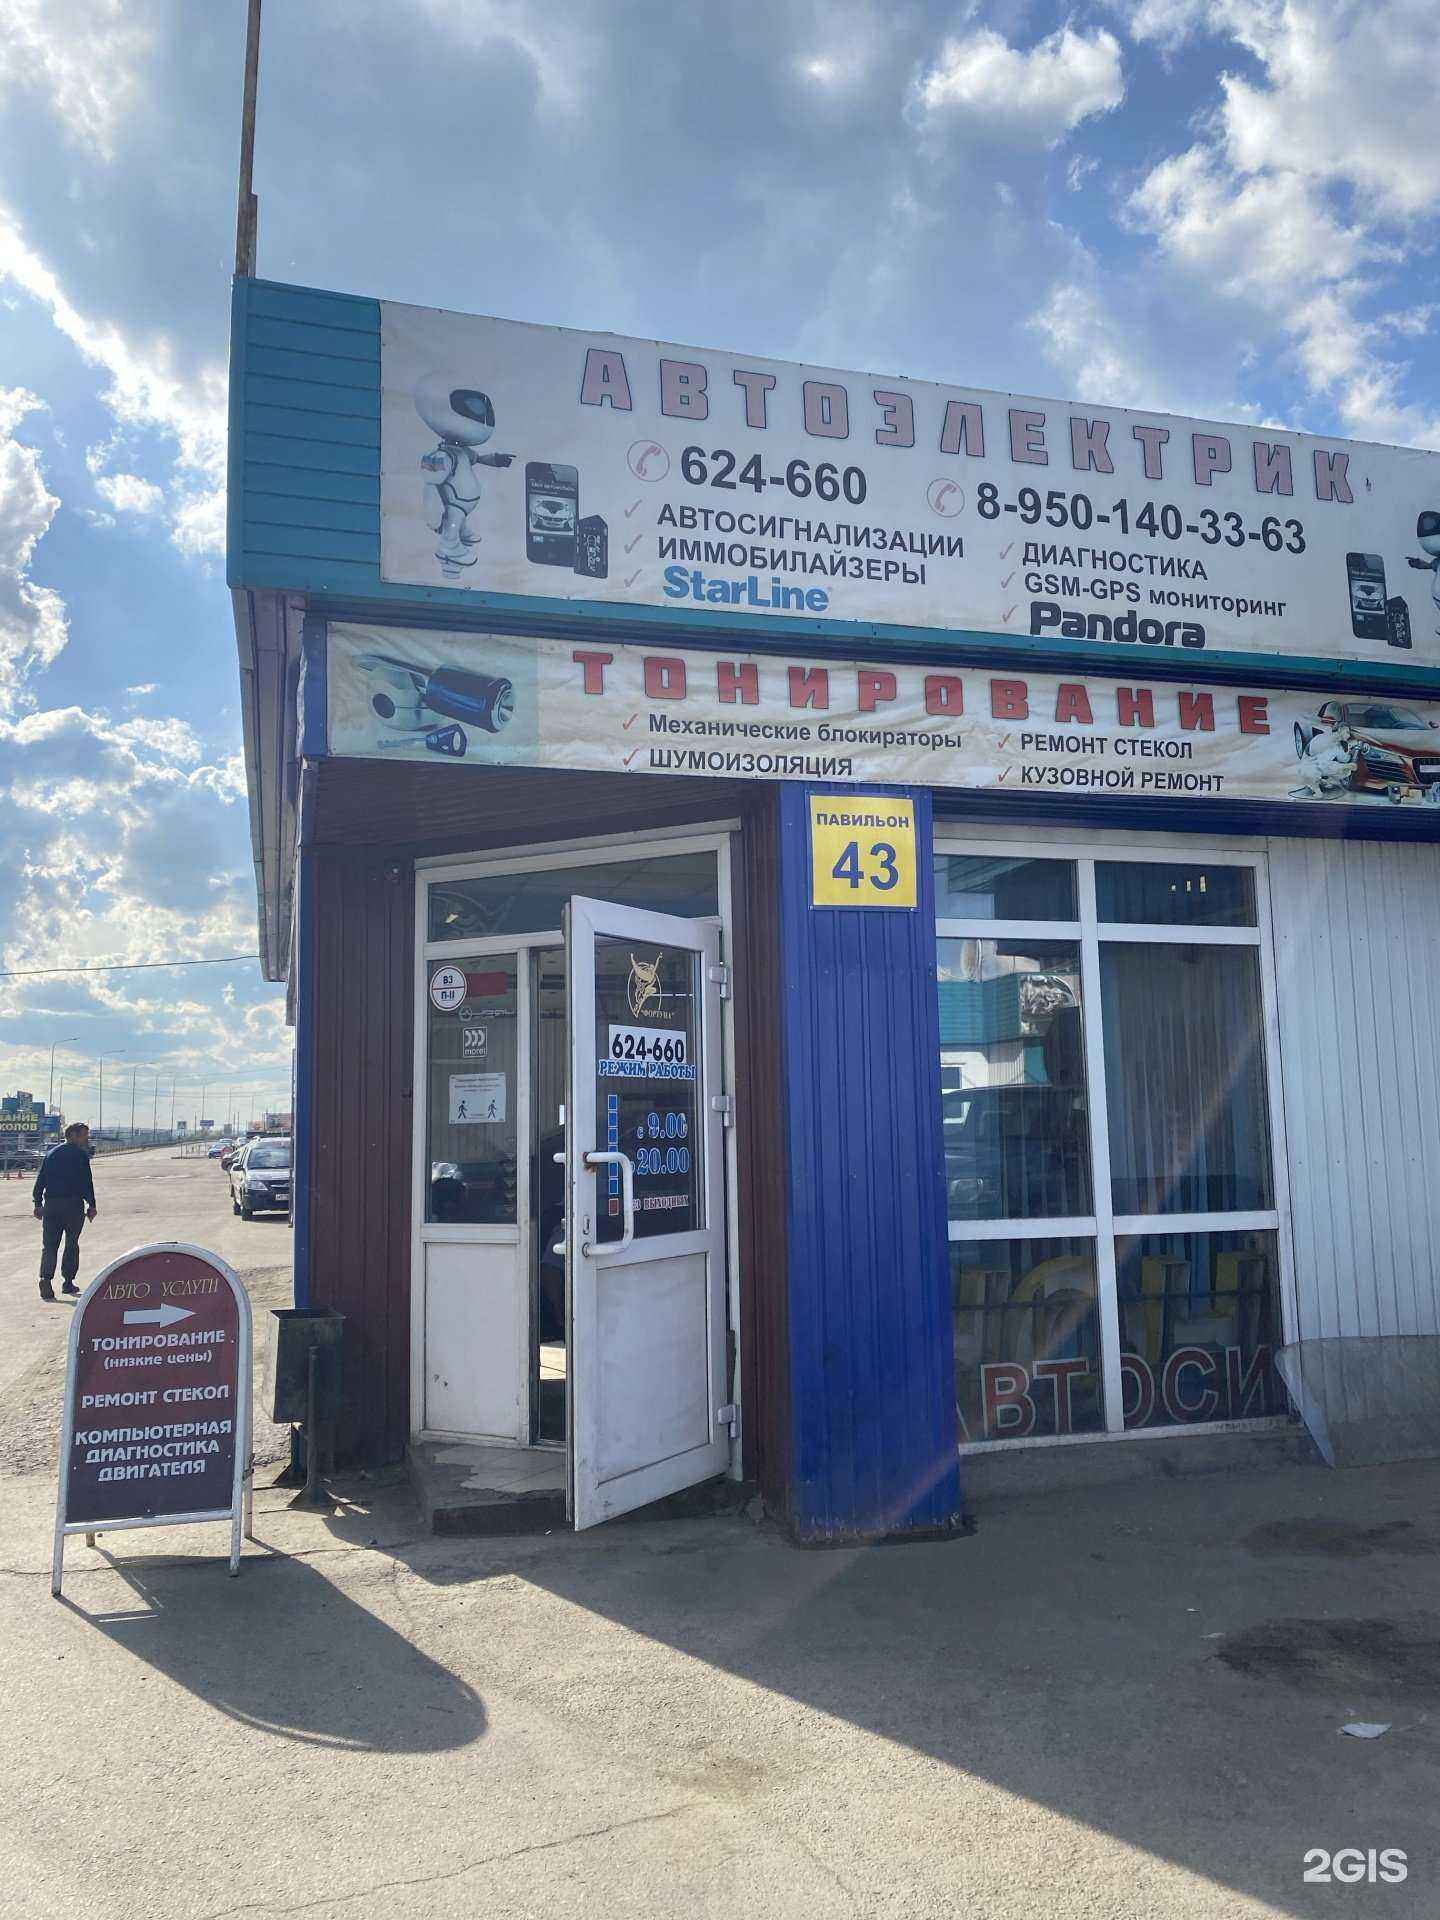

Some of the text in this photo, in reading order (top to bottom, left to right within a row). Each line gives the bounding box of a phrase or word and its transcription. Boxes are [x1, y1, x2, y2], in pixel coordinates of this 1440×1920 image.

[581, 348, 1353, 503] АВТОЭЛЕКТРИК
[681, 446, 867, 505] 624-660
[657, 503, 965, 558] АВТОСИГНАЛИЗАЦИИ
[977, 482, 1307, 554] 8-950-140-33-63
[658, 536, 926, 585] ИММОБИЛАЙЗЕРЫ
[1022, 542, 1208, 580] ДИАГНОСТИКА
[663, 566, 829, 612] StarLine
[1024, 572, 1287, 618] GSM-GPS мониторинг
[1031, 601, 1206, 649] Pandora
[572, 651, 1271, 735] ТОНИРОВАНИЕ
[649, 714, 962, 750] Механические блокираторы
[1021, 734, 1193, 759] РЕМОНТ СТЕКОЛ
[650, 748, 853, 777] ШУМОИЗОЛЯЦИЯ
[1021, 764, 1225, 793] КУЗОВНОЙ РЕМОНТ
[816, 813, 909, 828] ПАВИЛЬОН
[832, 841, 899, 890] 43
[612, 1034, 685, 1062] 624-660
[599, 1060, 696, 1079] РЕЖИМ РАБОТЫ
[637, 1147, 689, 1175] 20.00
[104, 1278, 219, 1300] АВТО УСЛУГИ
[92, 1330, 225, 1351] ТОНИРОВАНИЕ
[104, 1350, 212, 1369] (низкие цены)
[82, 1385, 229, 1408] РЕМОНТ СТЕКОЛ
[956, 1345, 1266, 1440] ВТОСИ
[75, 1420, 232, 1445] КОМПЬЮТЕРНАЯ
[86, 1439, 220, 1463] ДИАГНОСТИКА
[98, 1459, 206, 1482] ДВИГАТЕЛЯ
